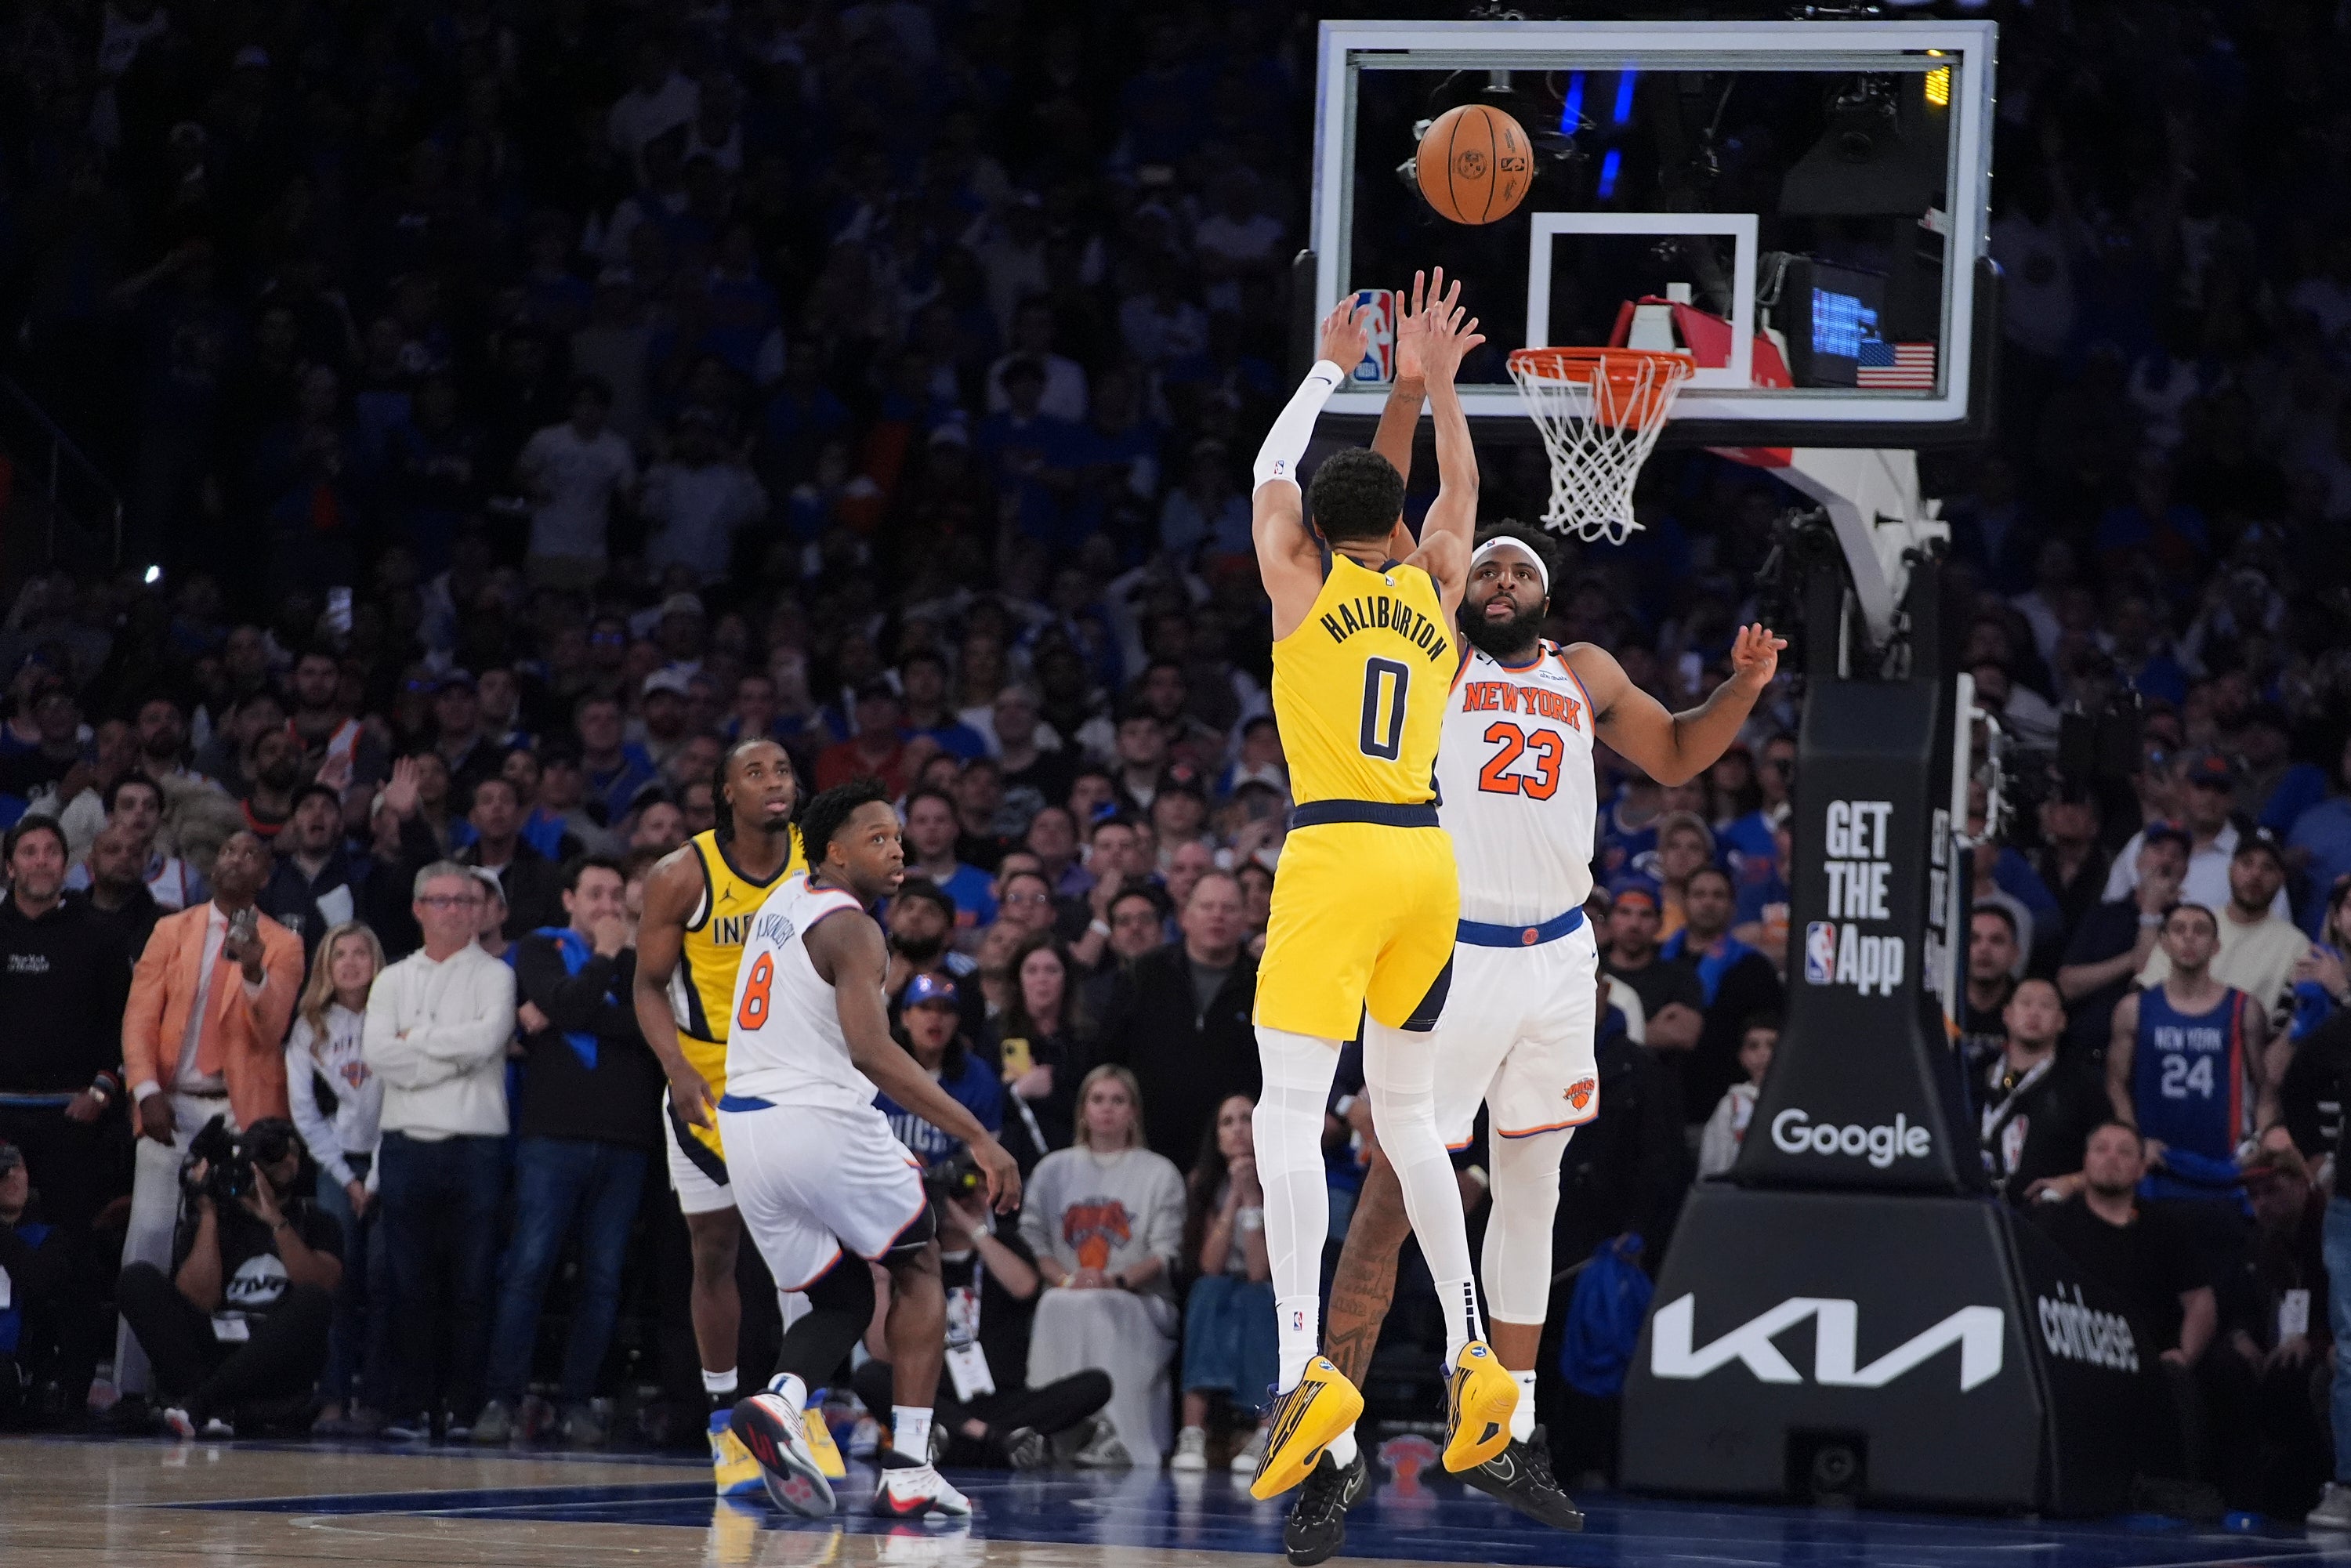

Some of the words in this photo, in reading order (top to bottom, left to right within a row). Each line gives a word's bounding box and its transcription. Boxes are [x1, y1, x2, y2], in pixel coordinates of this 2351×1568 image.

[1320, 596, 1447, 662] HALIBURTON
[1359, 655, 1411, 762] 0
[1462, 681, 1519, 712] NEW
[1520, 687, 1581, 732] YORK
[1479, 722, 1564, 801] 23
[1826, 799, 1893, 859] GET
[1824, 860, 1892, 919] THE
[737, 951, 774, 1030] 8
[1836, 923, 1904, 997] App
[2161, 1054, 2213, 1099] 24
[1771, 1107, 1932, 1168] Google
[1651, 1292, 2004, 1392] KIA
[2038, 1280, 2139, 1372] coinbase
